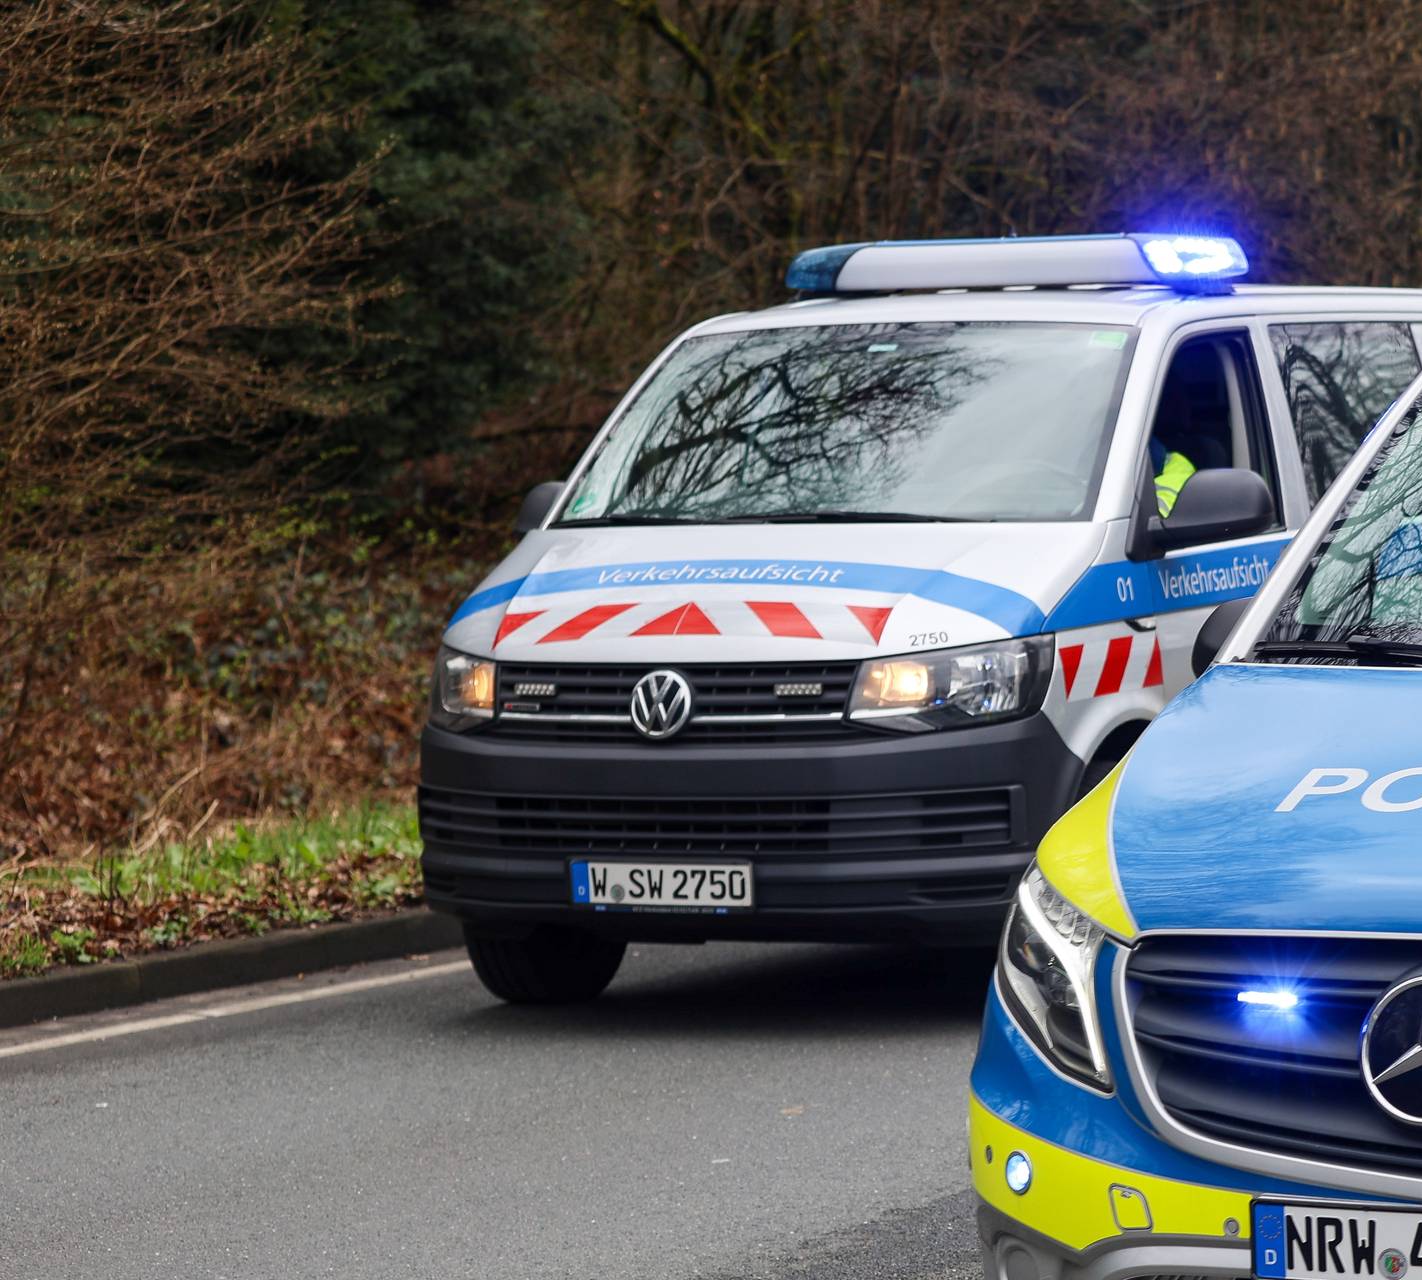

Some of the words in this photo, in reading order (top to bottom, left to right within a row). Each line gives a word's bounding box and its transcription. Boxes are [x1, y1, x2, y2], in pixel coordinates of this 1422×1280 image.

[598, 563, 844, 585] Verkehrsaufsicht
[1116, 576, 1135, 602] 01
[1158, 554, 1270, 599] Verkehrsaufsicht
[908, 630, 949, 648] 2750
[591, 866, 608, 899] W
[629, 868, 663, 900] SW
[672, 869, 746, 901] 2750
[1264, 1249, 1278, 1266] D
[1285, 1213, 1376, 1275] NRW
